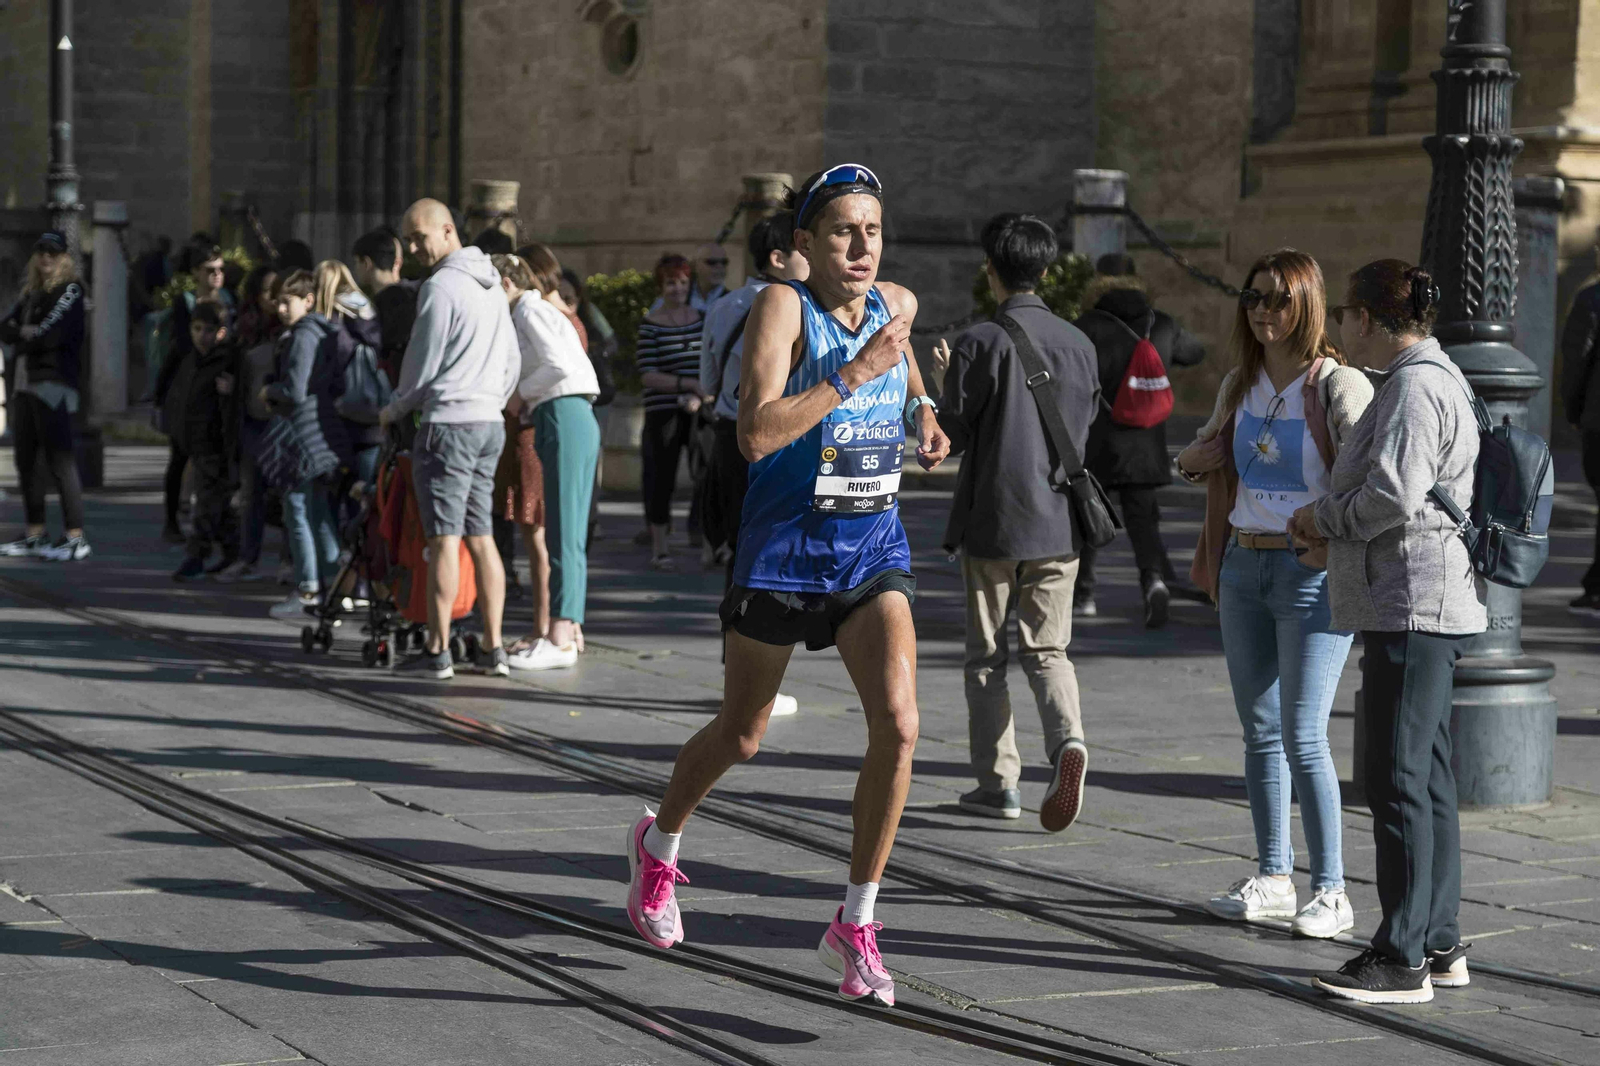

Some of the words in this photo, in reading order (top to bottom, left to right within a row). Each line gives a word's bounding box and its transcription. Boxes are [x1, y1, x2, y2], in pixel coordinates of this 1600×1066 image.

[856, 425, 899, 440] ZURICH
[862, 454, 879, 470] 55
[847, 480, 881, 492] RIVERO
